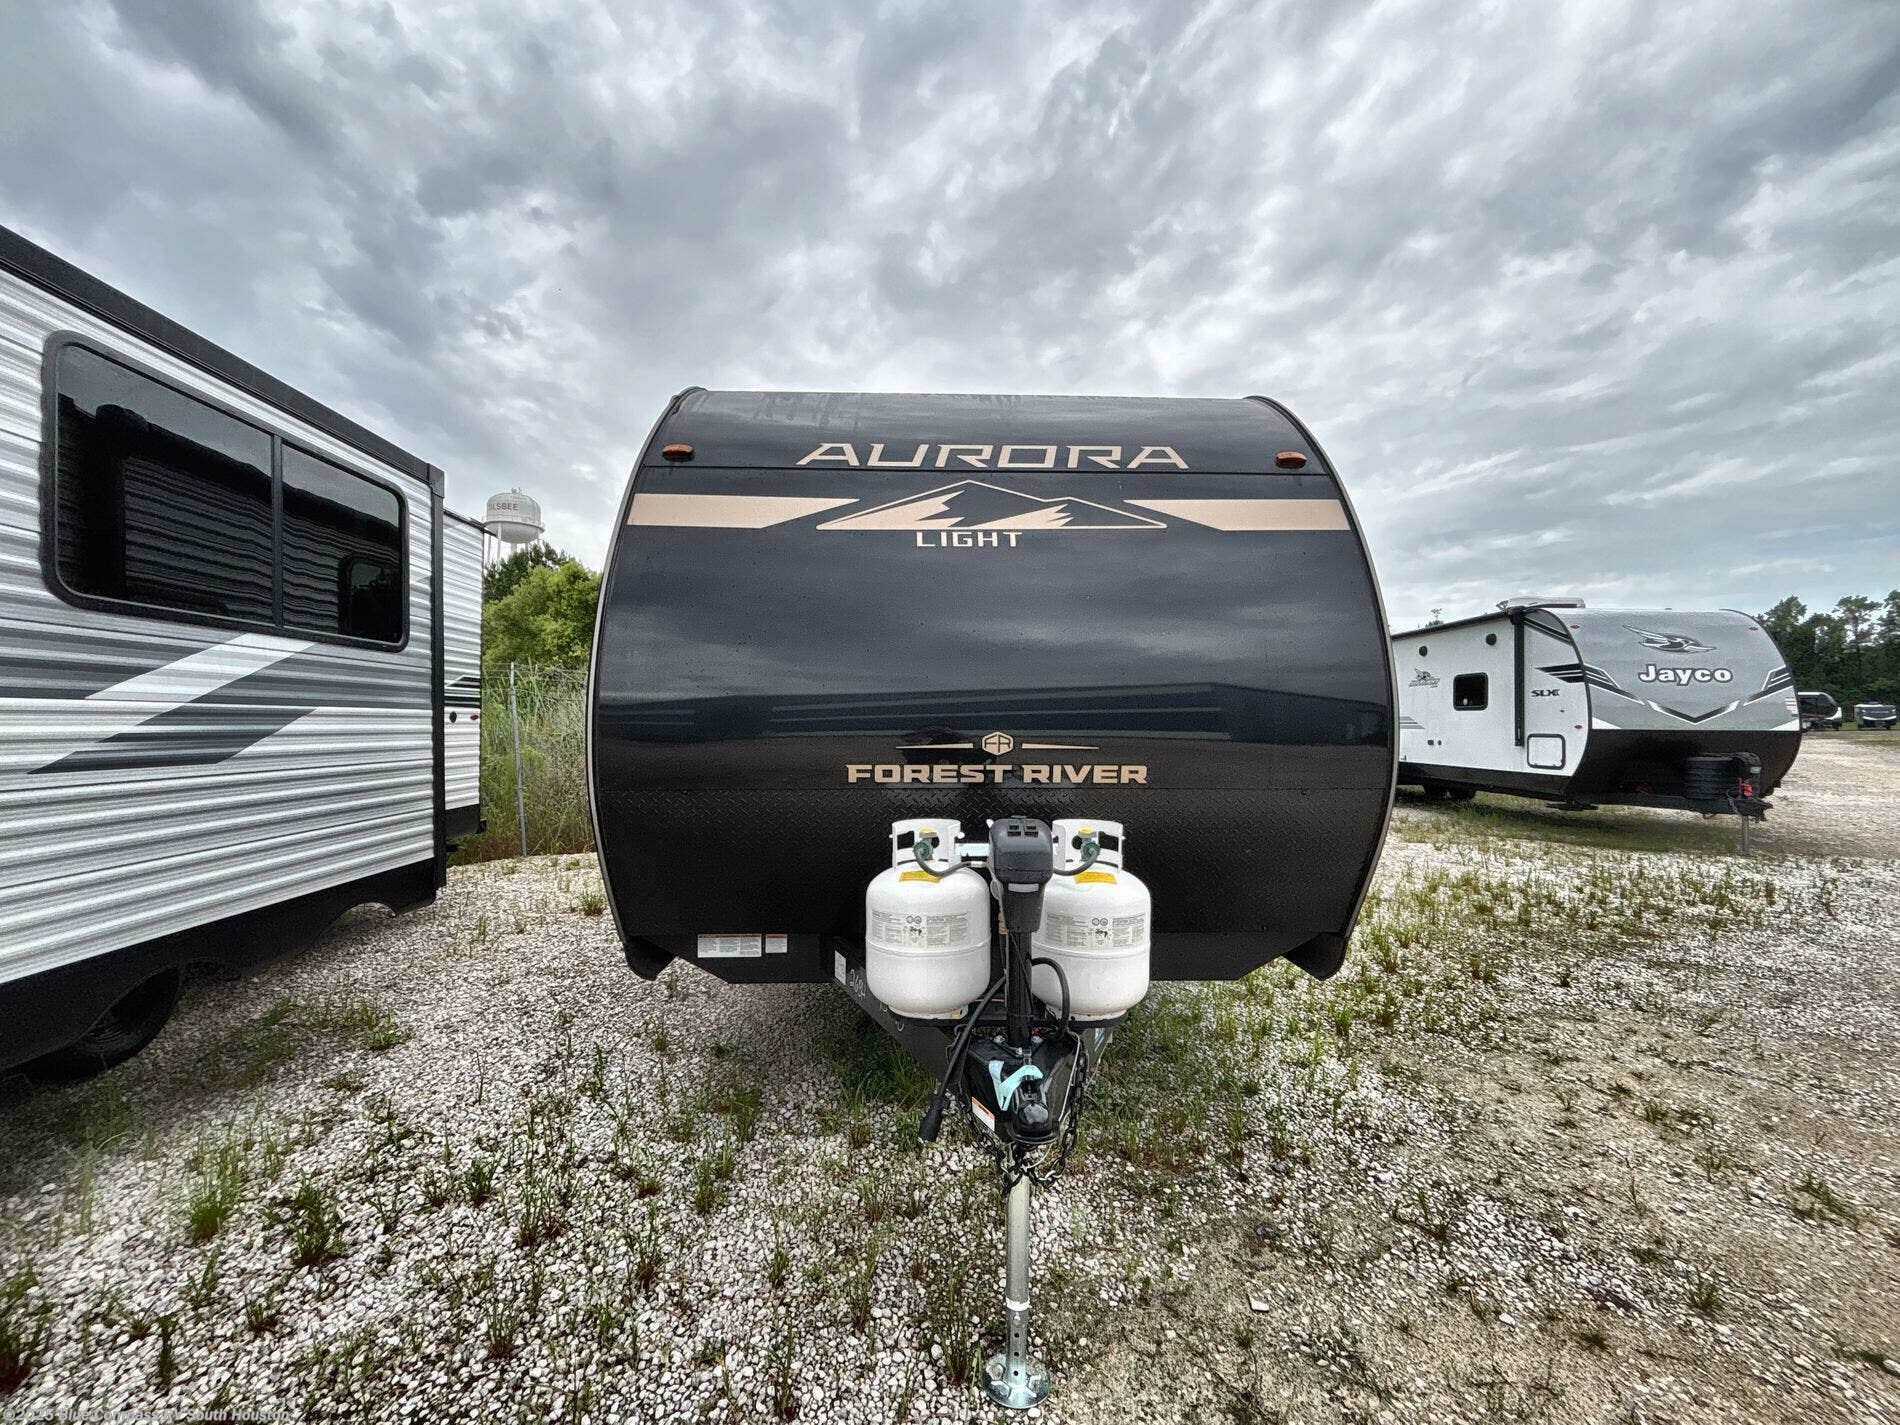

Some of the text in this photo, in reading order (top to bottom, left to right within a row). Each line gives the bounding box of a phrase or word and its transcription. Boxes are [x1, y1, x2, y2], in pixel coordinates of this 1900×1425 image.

[795, 442, 1190, 470] AURORA
[915, 531, 1023, 548] LIGHT
[1638, 663, 1734, 687] Jayco
[845, 764, 1148, 784] FOREST RIVER
